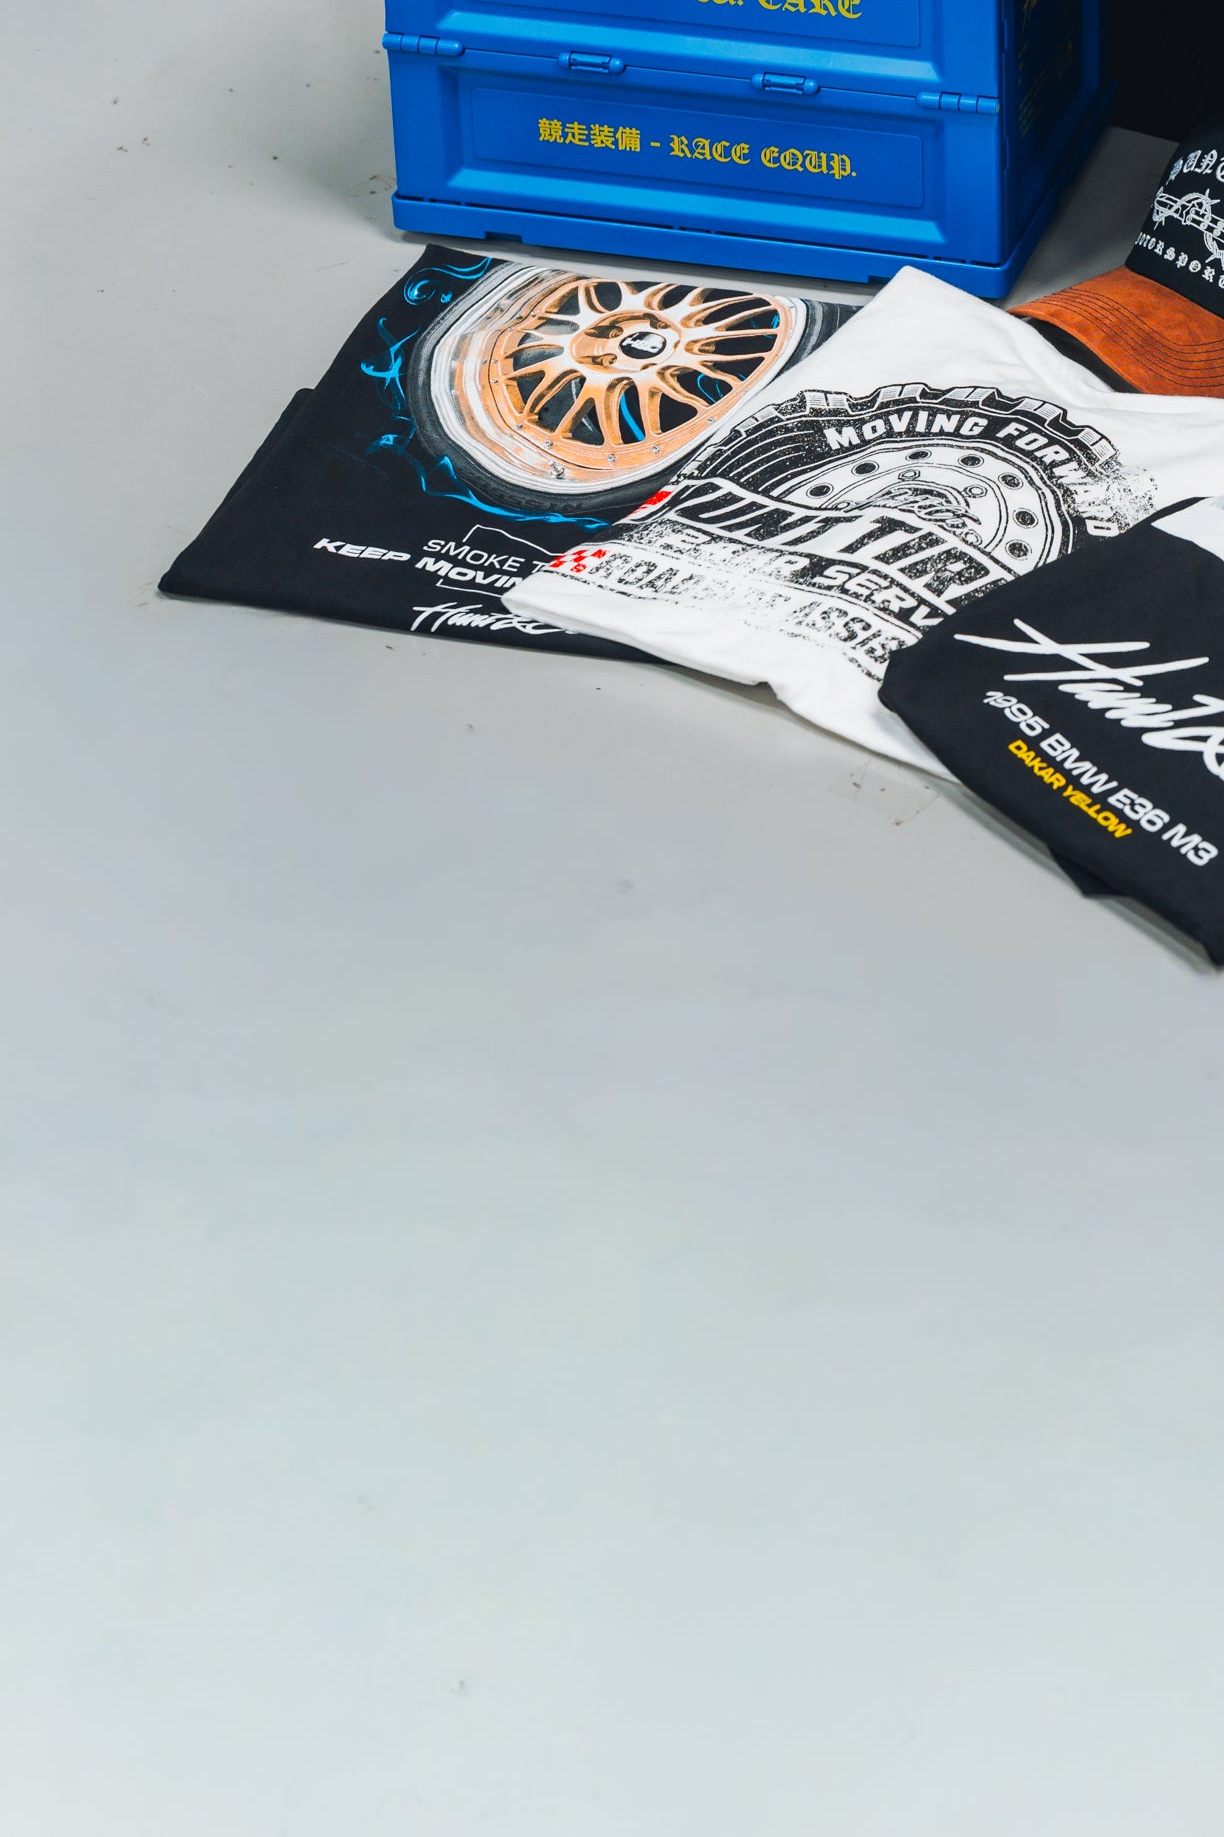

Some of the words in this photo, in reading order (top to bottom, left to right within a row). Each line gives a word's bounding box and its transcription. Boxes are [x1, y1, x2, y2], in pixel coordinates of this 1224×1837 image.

[538, 118, 641, 152] 競走装備
[669, 135, 751, 164] RACE
[760, 146, 857, 180] EQUP.
[823, 410, 988, 450] MOVING
[313, 538, 411, 562] KEEP
[423, 539, 525, 572] SMOKE
[838, 515, 1012, 606] TIR
[410, 602, 582, 634] Hunt&C
[983, 691, 1050, 737] 1995
[1039, 733, 1118, 794] BMW
[1107, 788, 1170, 833] E36
[1161, 823, 1219, 867] M3
[1008, 739, 1067, 790] DAKAR
[1062, 785, 1133, 838] YELLOW
